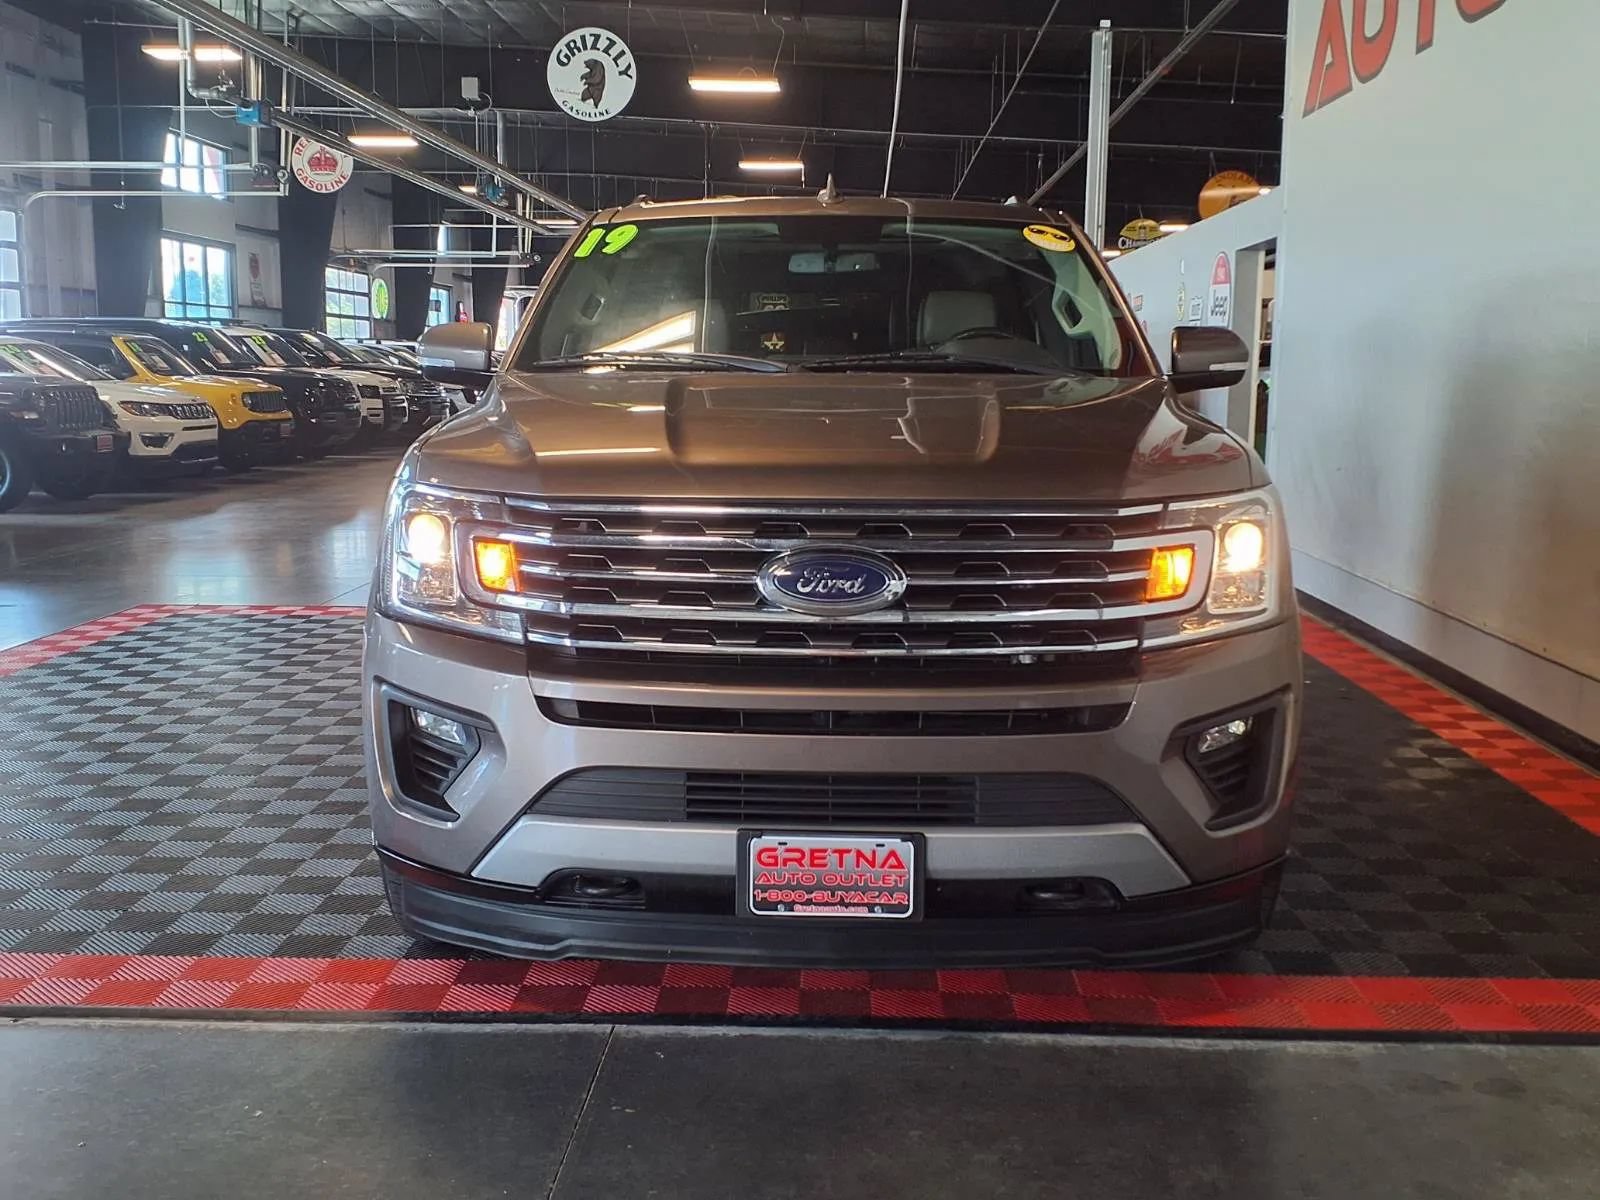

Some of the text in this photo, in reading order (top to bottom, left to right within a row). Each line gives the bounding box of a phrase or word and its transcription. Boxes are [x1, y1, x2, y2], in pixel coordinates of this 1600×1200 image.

[556, 33, 633, 80] GRIZZLY
[1302, 0, 1507, 119] AU
[562, 100, 612, 118] GASOLINE
[296, 168, 349, 191] GASOLINE
[573, 224, 639, 258] 19
[1210, 289, 1229, 322] Jeep
[797, 567, 867, 594] Ford
[756, 847, 908, 871] GRETNA
[755, 871, 908, 888] AUTO OUTLET
[754, 889, 908, 905] 1-800-BUYACAR
